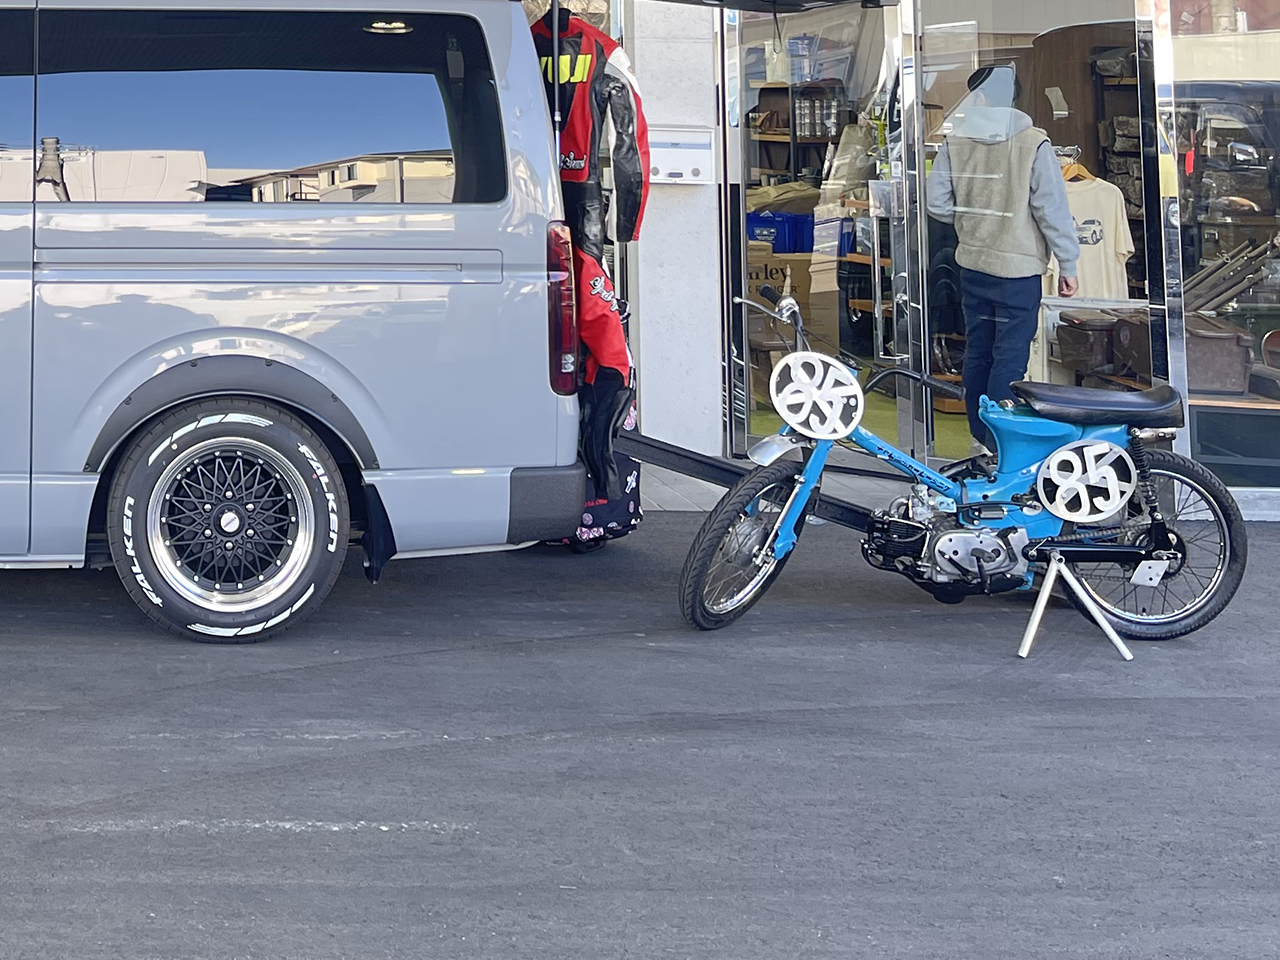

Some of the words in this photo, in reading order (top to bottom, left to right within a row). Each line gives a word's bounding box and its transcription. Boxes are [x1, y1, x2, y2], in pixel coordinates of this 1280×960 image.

[779, 355, 853, 434] 85
[297, 442, 339, 553] FALKEN
[1049, 442, 1121, 517] 85
[123, 496, 163, 607] FALKEN
